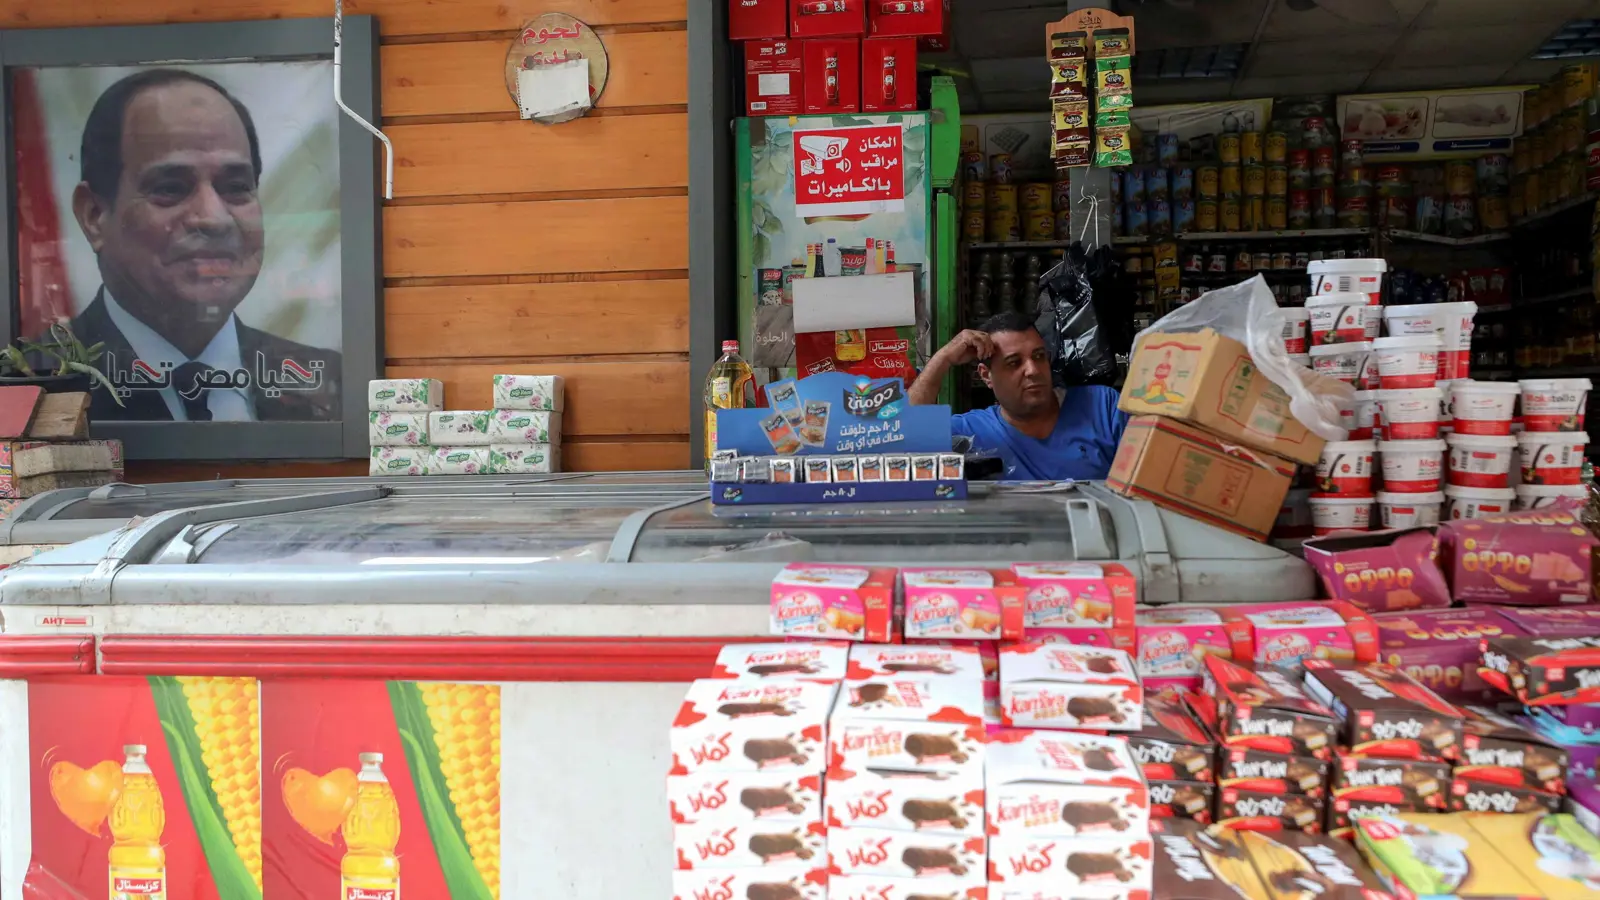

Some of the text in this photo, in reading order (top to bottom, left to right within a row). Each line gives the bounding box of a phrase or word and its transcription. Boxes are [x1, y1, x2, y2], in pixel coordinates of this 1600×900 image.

[522, 22, 582, 46] لحوم
[859, 136, 896, 152] المكان
[860, 154, 898, 171] مراقب
[807, 177, 891, 198] بالكاميرات
[755, 331, 787, 346] الحلوة
[871, 341, 906, 352] كريستال
[107, 350, 324, 400] تحيا مصر تحيا
[848, 387, 894, 410] دومتي
[836, 440, 854, 452] وقت
[882, 433, 904, 444] معاك
[690, 732, 733, 765] كمارا
[687, 779, 729, 813] كمارا
[845, 789, 893, 820] كمارا
[695, 826, 738, 860] كمارا
[845, 836, 893, 867] كمارا
[1009, 842, 1057, 876] كمارا
[115, 880, 161, 892] كريستال
